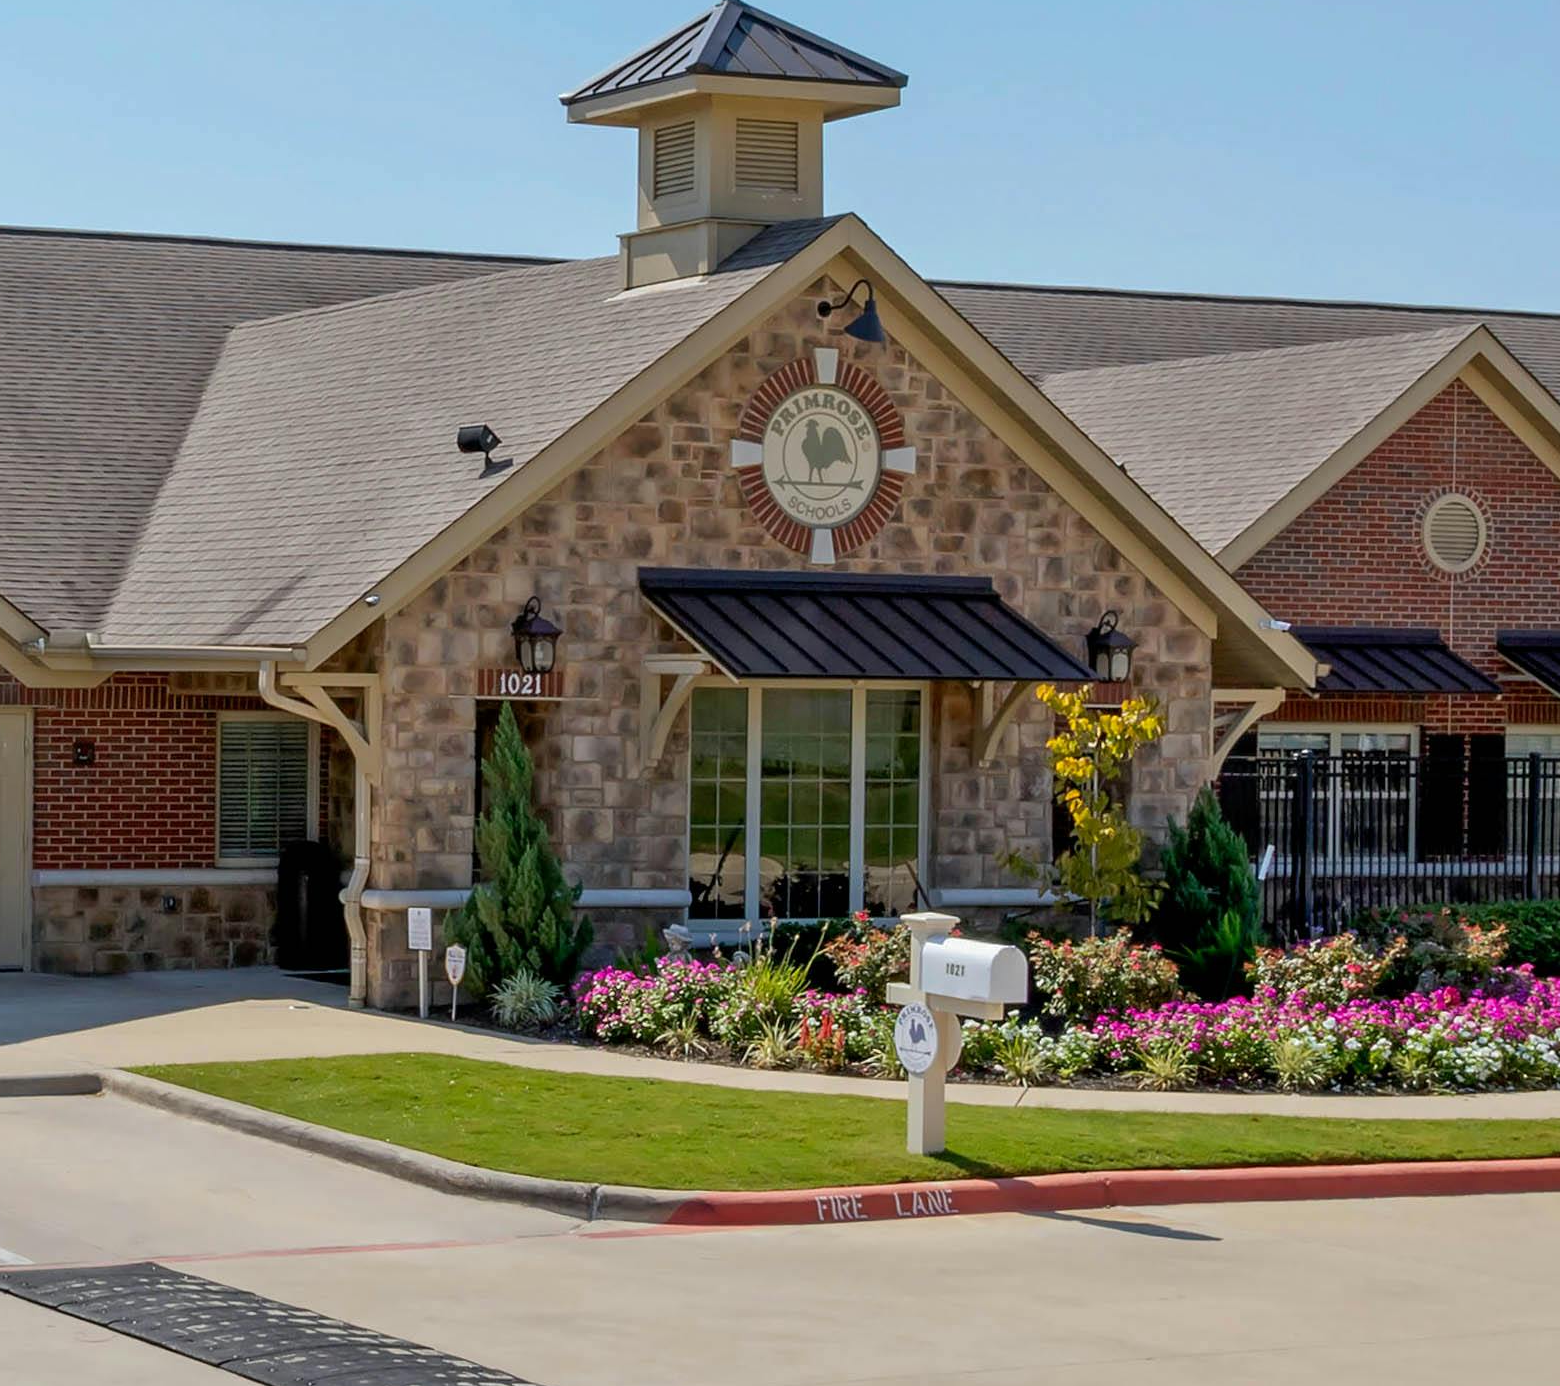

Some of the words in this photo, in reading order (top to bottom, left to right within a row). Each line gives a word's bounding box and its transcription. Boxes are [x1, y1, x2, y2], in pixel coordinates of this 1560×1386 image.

[771, 393, 870, 440] PRIMROSE
[788, 496, 852, 520] SCHOOLS
[500, 672, 542, 695] 1021
[946, 963, 965, 976] 1021
[815, 1194, 869, 1221] FIRE
[894, 1189, 960, 1217] LANE
